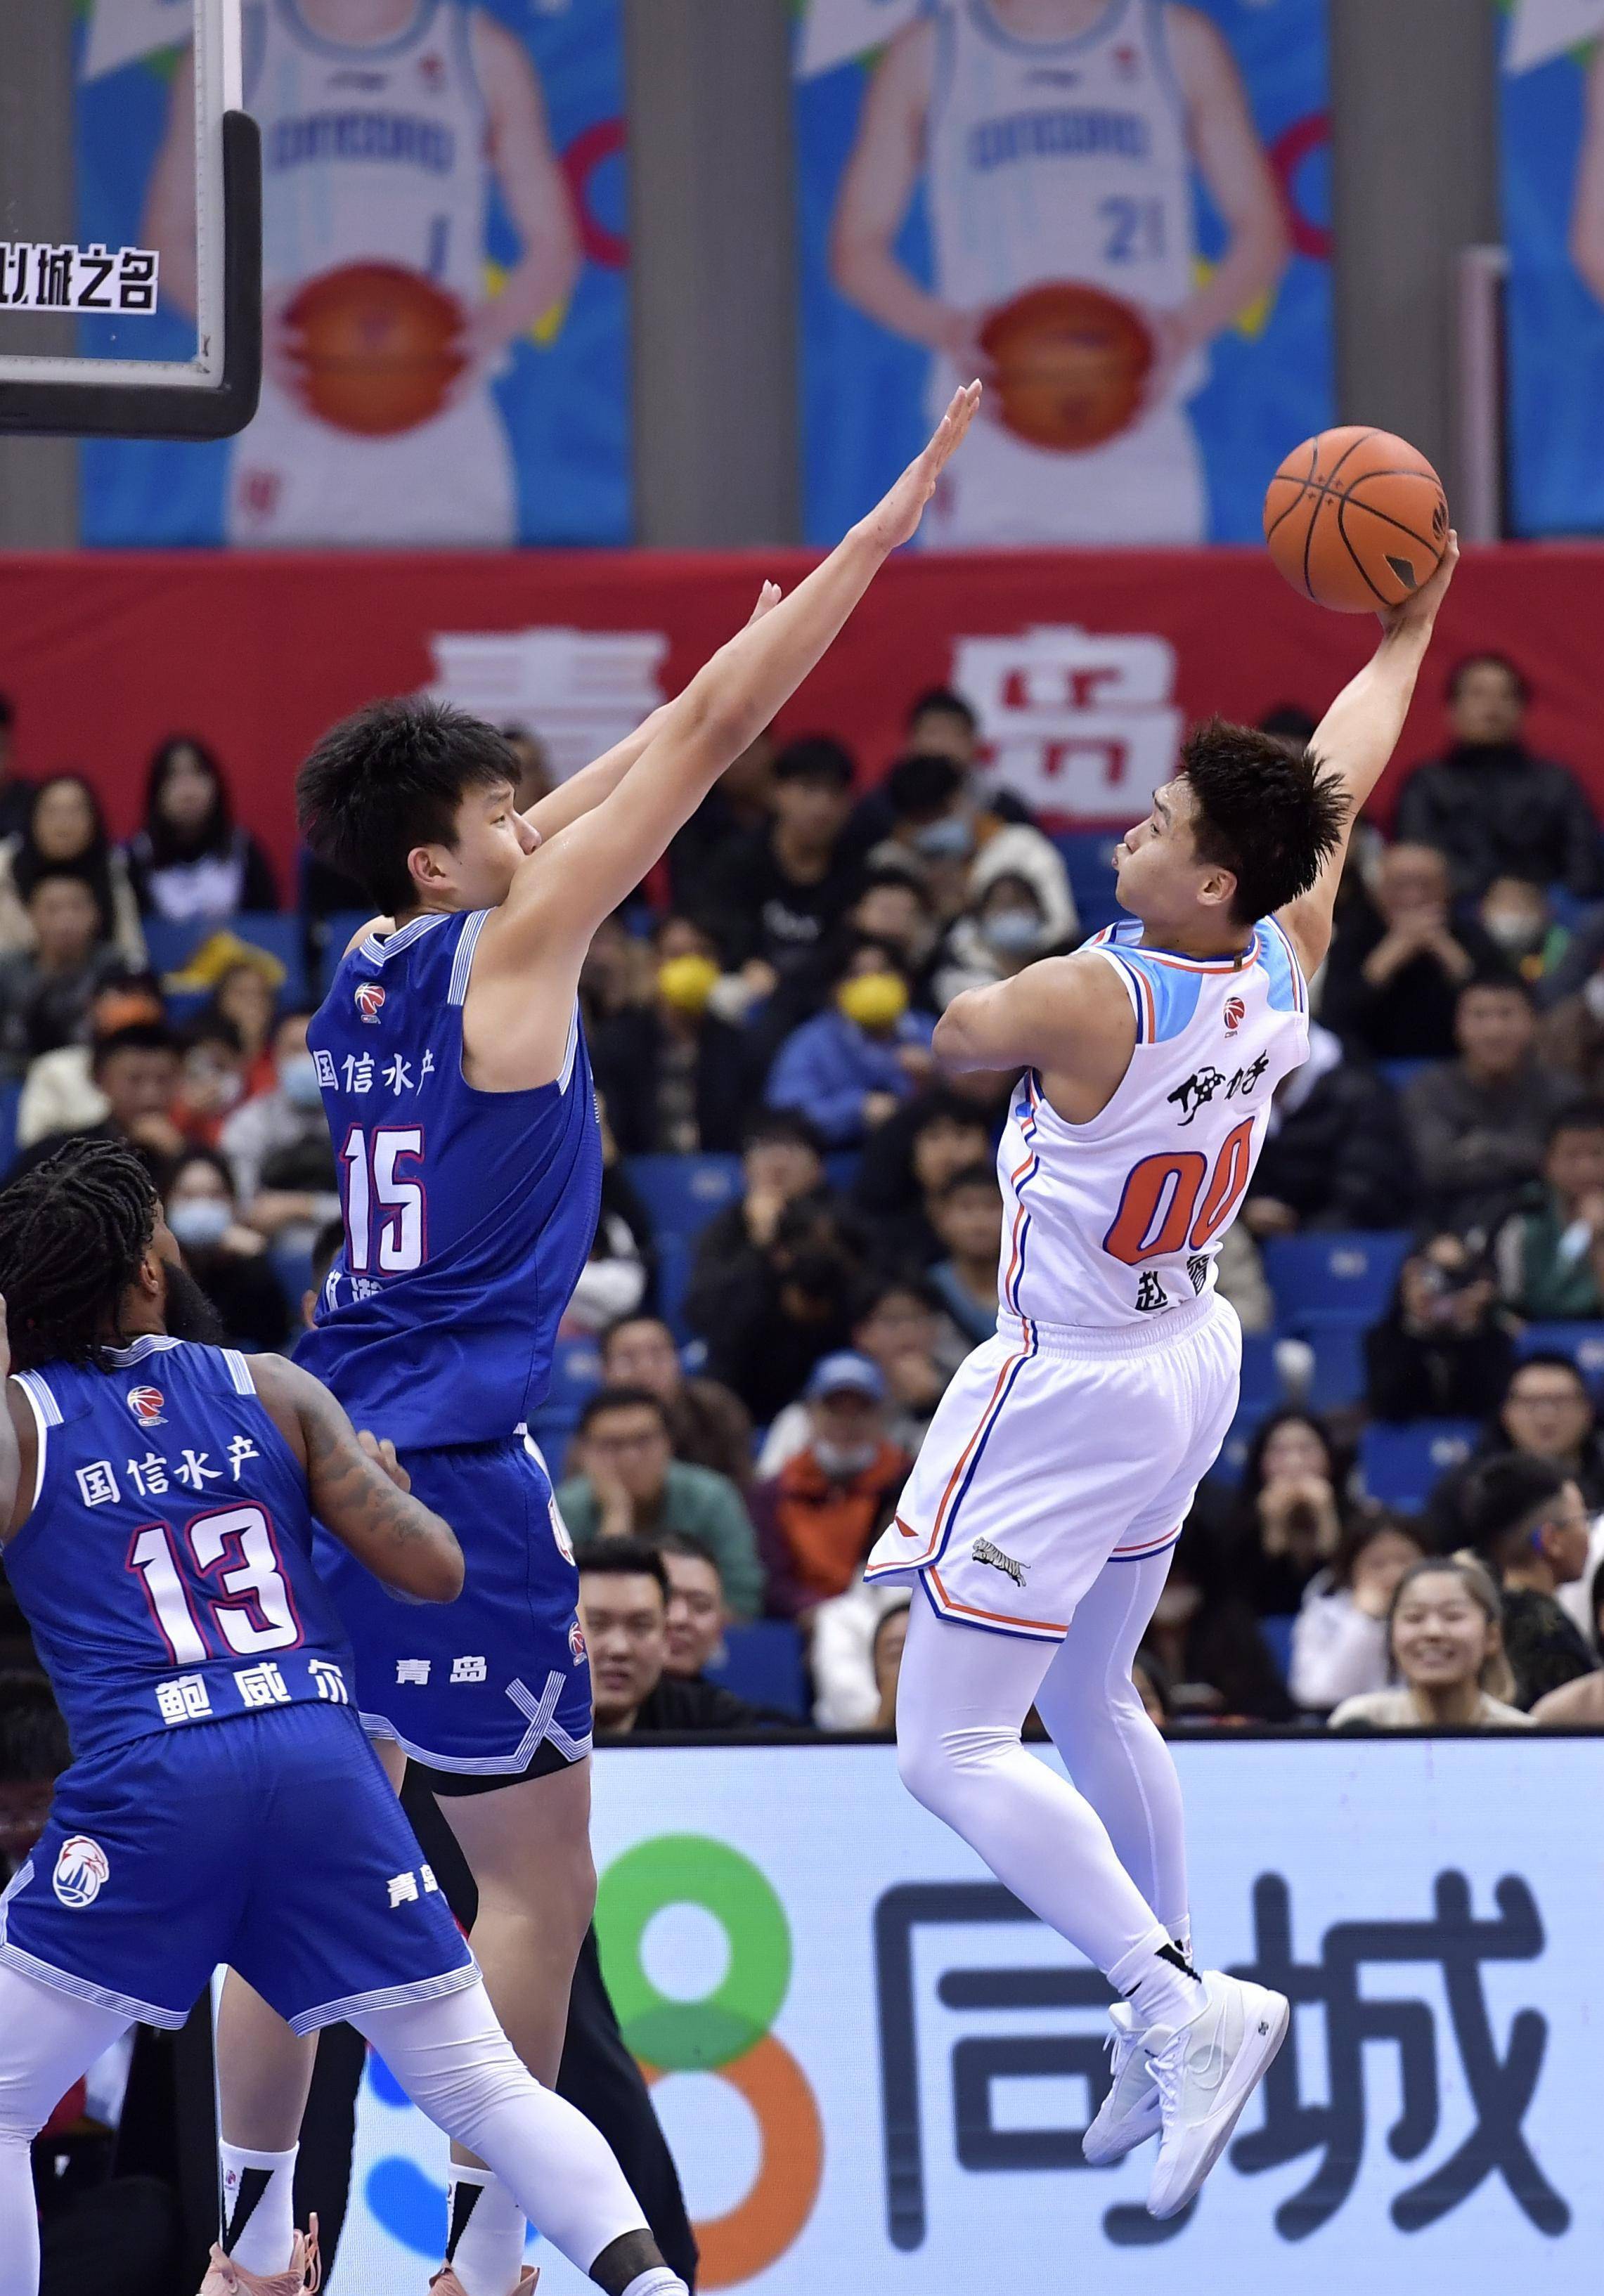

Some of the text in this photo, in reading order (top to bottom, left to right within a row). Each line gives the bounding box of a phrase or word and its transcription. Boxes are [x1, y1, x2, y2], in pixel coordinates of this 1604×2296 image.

[313, 1049, 436, 1096] 国信水产
[341, 1124, 427, 1276] 15
[1102, 1116, 1255, 1266] 00
[76, 1435, 260, 1507] 国信水产
[125, 1500, 305, 1666] 13
[155, 1659, 349, 1725] 鲍威尔
[395, 1656, 488, 1685] 青岛
